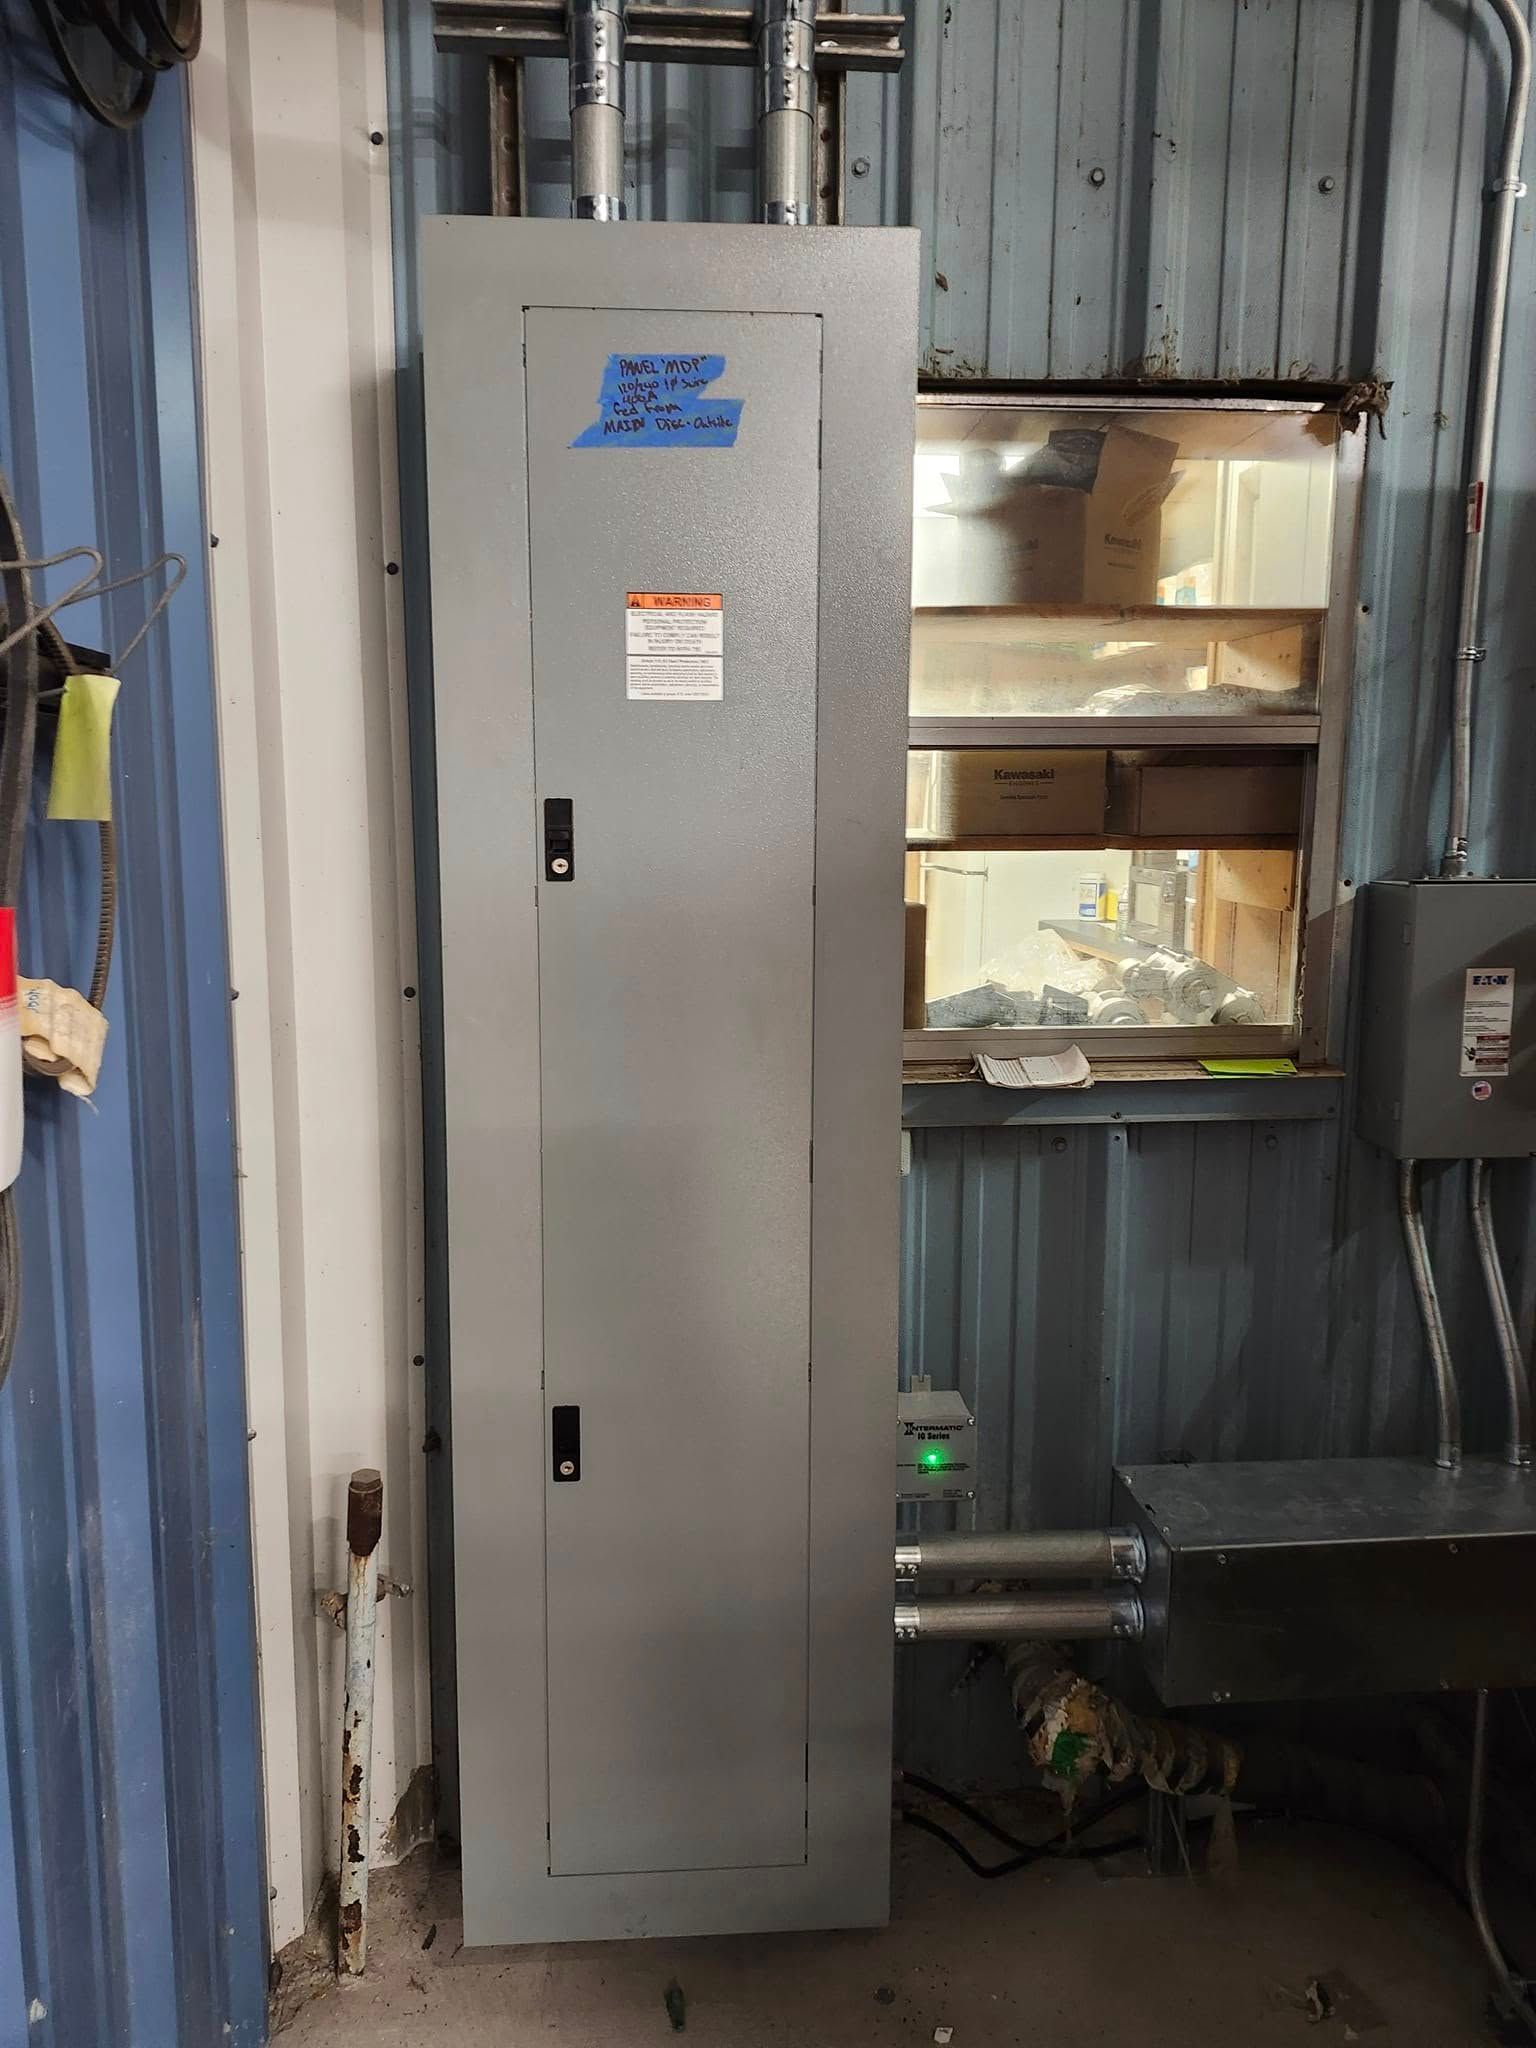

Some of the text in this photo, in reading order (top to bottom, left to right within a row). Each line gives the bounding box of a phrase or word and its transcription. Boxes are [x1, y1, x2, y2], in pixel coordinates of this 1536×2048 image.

[619, 359, 660, 377] PANEL
[653, 596, 711, 609] WARNING
[993, 769, 1056, 780] Kawasaki
[904, 1422, 964, 1436] INTERMATIC
[927, 1432, 950, 1440] Series
